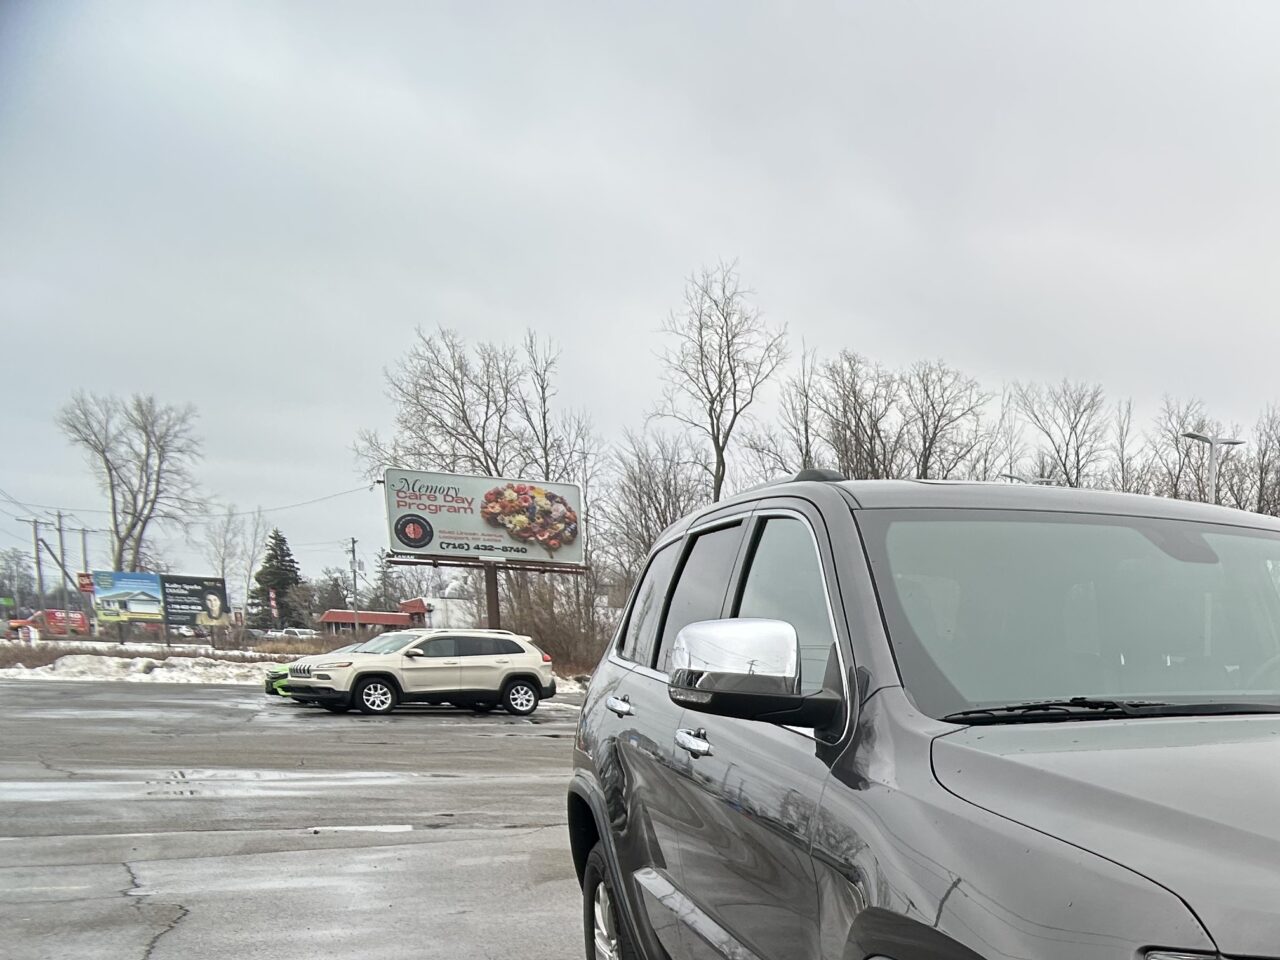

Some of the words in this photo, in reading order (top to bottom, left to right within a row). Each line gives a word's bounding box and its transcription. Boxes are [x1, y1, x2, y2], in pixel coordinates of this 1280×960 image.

[390, 477, 460, 497] Memory
[396, 490, 438, 502] Care
[443, 493, 475, 507] Day
[396, 500, 474, 514] Program
[439, 541, 470, 551] (716)
